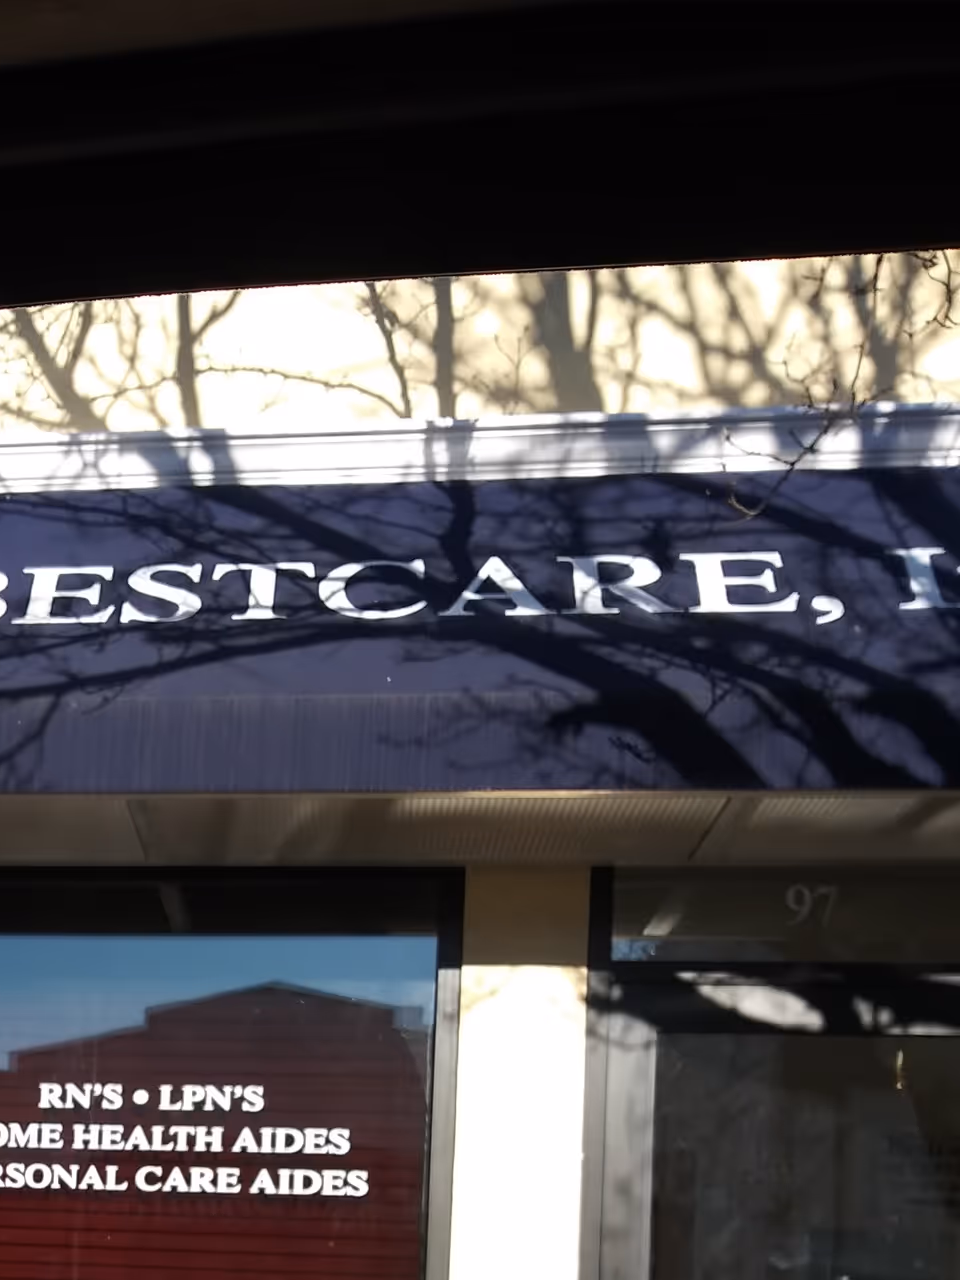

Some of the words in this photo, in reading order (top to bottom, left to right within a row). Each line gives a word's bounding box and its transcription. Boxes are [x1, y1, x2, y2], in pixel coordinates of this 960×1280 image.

[887, 546, 960, 611] I
[784, 883, 838, 928] 97
[37, 1082, 124, 1110] RN'S
[158, 1083, 265, 1113] LPN'S
[71, 1123, 225, 1153] HEALTH
[231, 1126, 351, 1156] AIDES
[134, 1165, 242, 1194] CARE
[249, 1168, 370, 1197] AIDES
